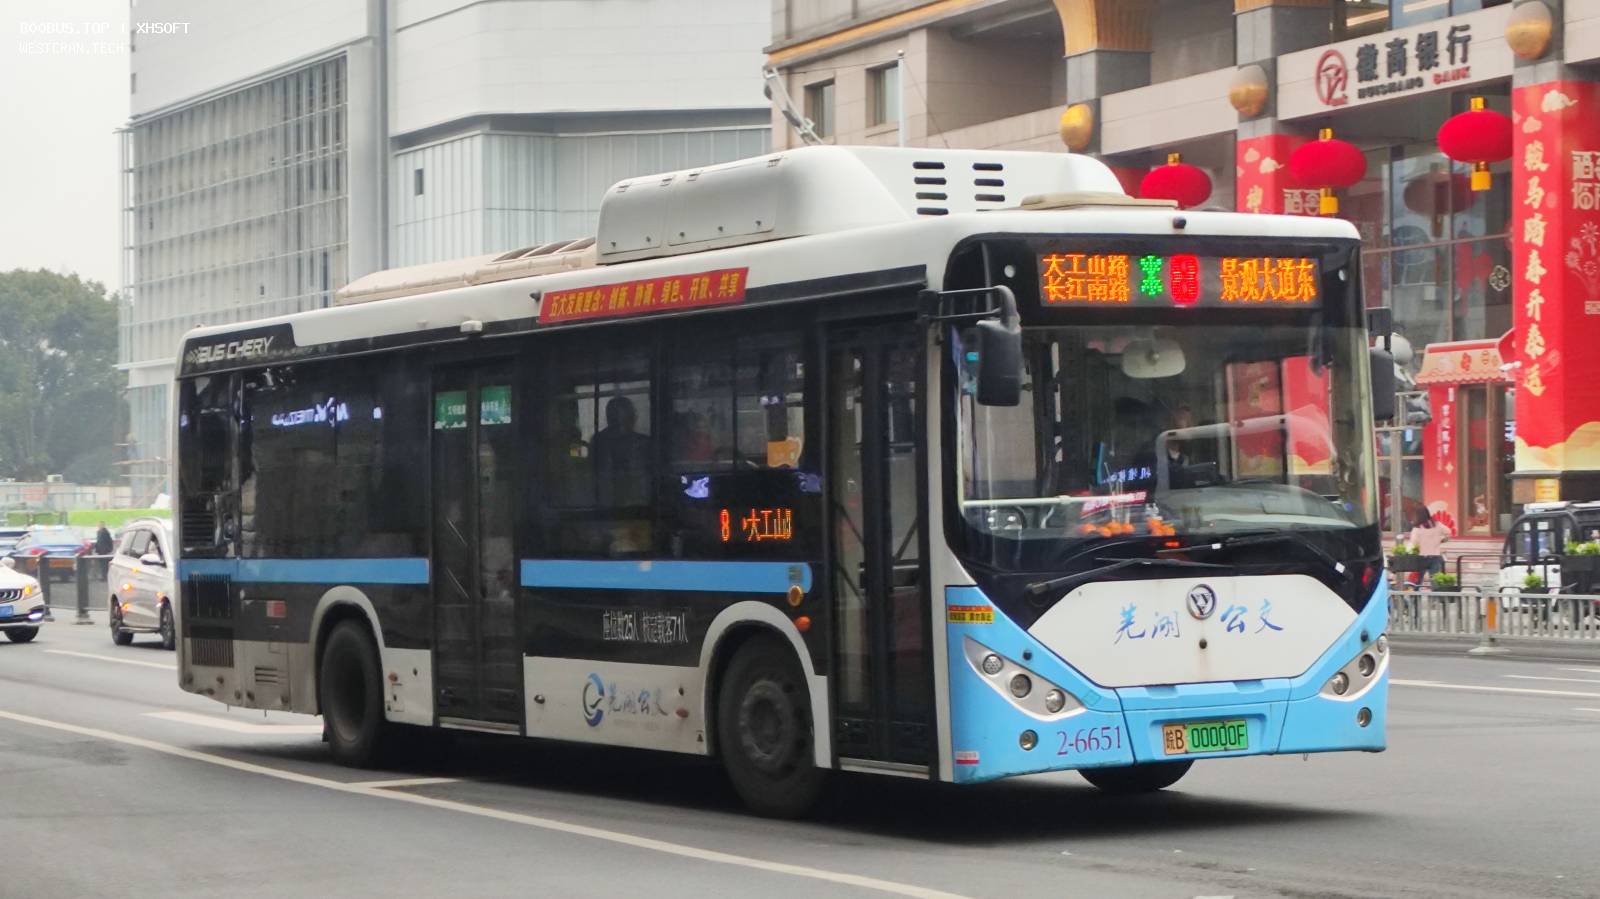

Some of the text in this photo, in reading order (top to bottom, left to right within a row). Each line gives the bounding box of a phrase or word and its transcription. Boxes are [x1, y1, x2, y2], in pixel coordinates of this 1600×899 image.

[1356, 24, 1472, 83] 徽商银行
[1432, 66, 1471, 85] BANK
[1042, 253, 1129, 276] 大工山路
[1170, 254, 1200, 304] 8
[1219, 256, 1317, 302] 景观大道东
[1043, 276, 1130, 302] 长江南路
[198, 336, 274, 363] BUS CHERY
[720, 509, 730, 541] 8
[1113, 598, 1284, 645] 芜湖 公交
[1056, 725, 1121, 756] 2-6651
